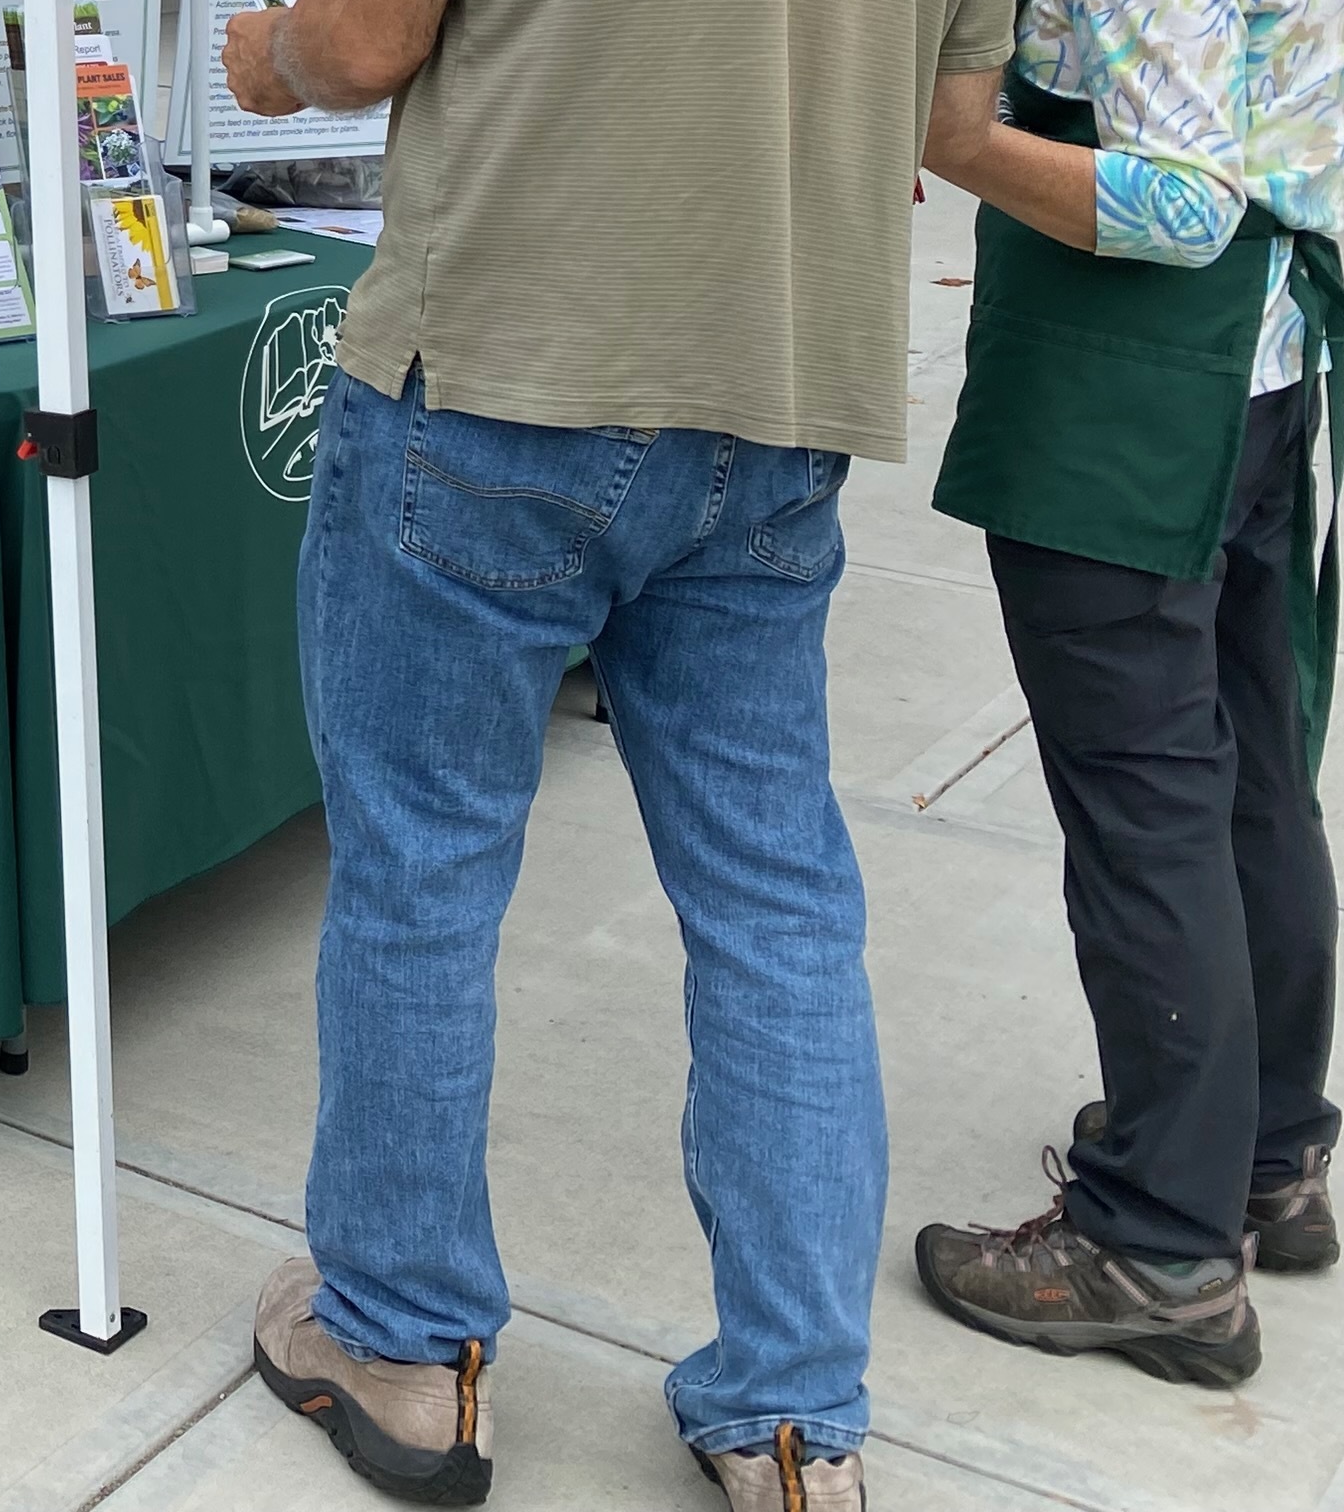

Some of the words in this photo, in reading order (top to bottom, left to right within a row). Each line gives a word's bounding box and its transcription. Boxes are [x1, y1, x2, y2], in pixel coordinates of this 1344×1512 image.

[74, 21, 93, 31] lant
[77, 74, 101, 84] PLANT
[102, 72, 126, 82] SALES
